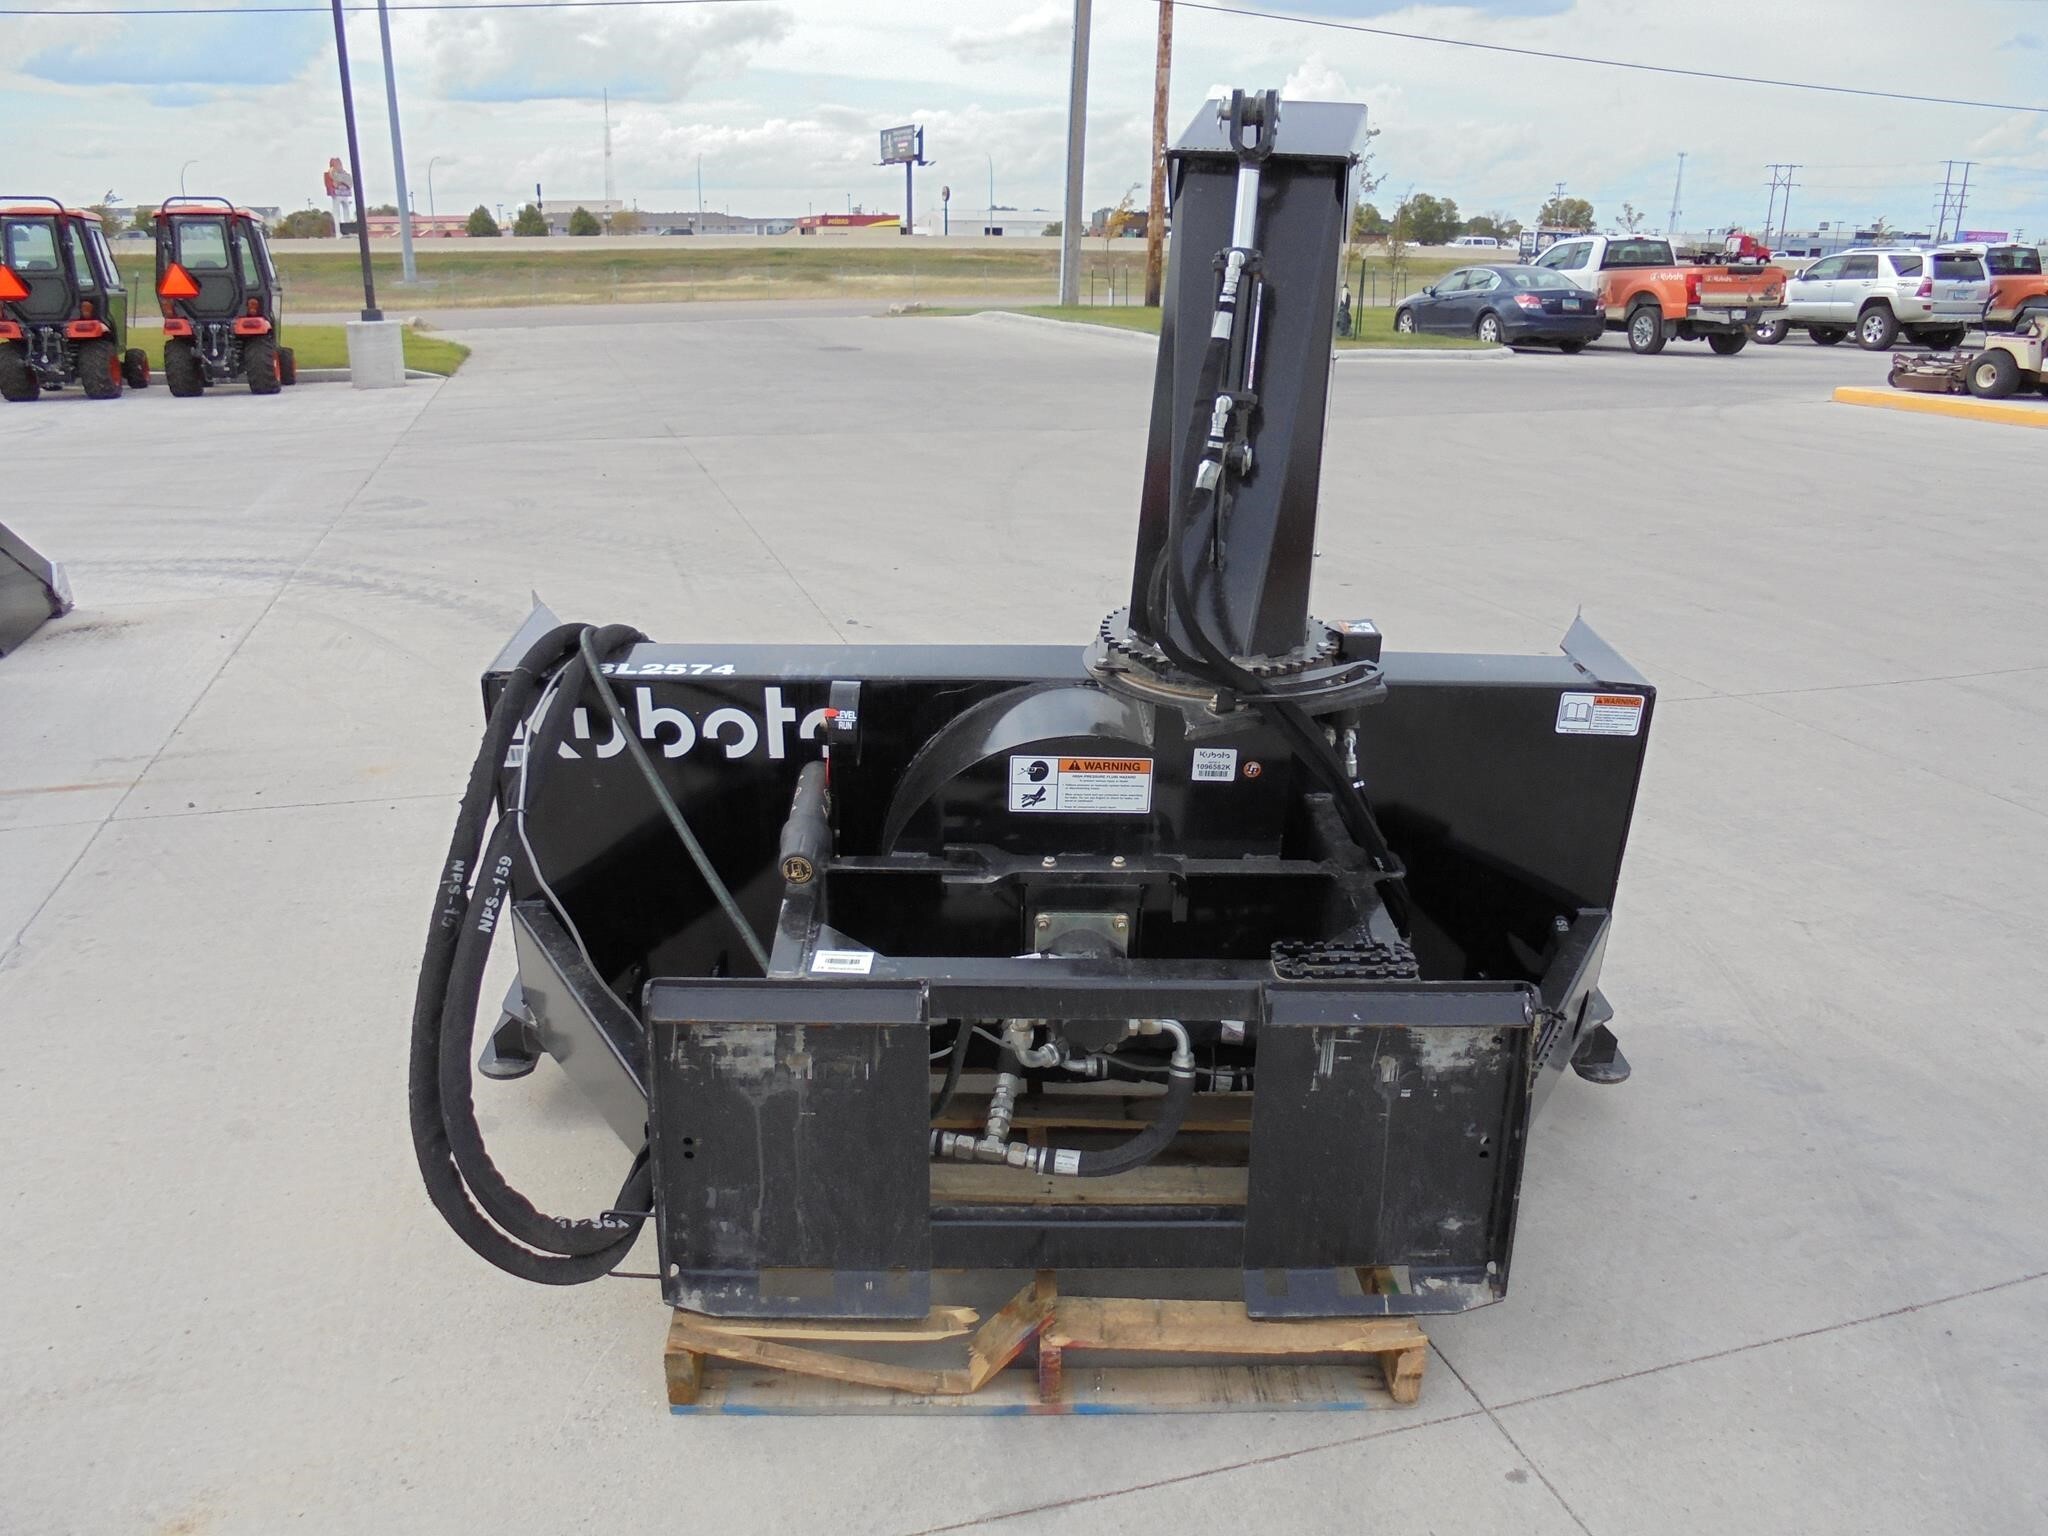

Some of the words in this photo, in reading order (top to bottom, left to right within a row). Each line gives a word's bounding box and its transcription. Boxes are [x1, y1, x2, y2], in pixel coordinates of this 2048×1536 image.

[1603, 697, 1640, 706] WARNING
[838, 721, 853, 730] RUN
[1199, 751, 1231, 759] Kubota
[1084, 761, 1141, 771] WARNING
[478, 855, 512, 933] NPS-159
